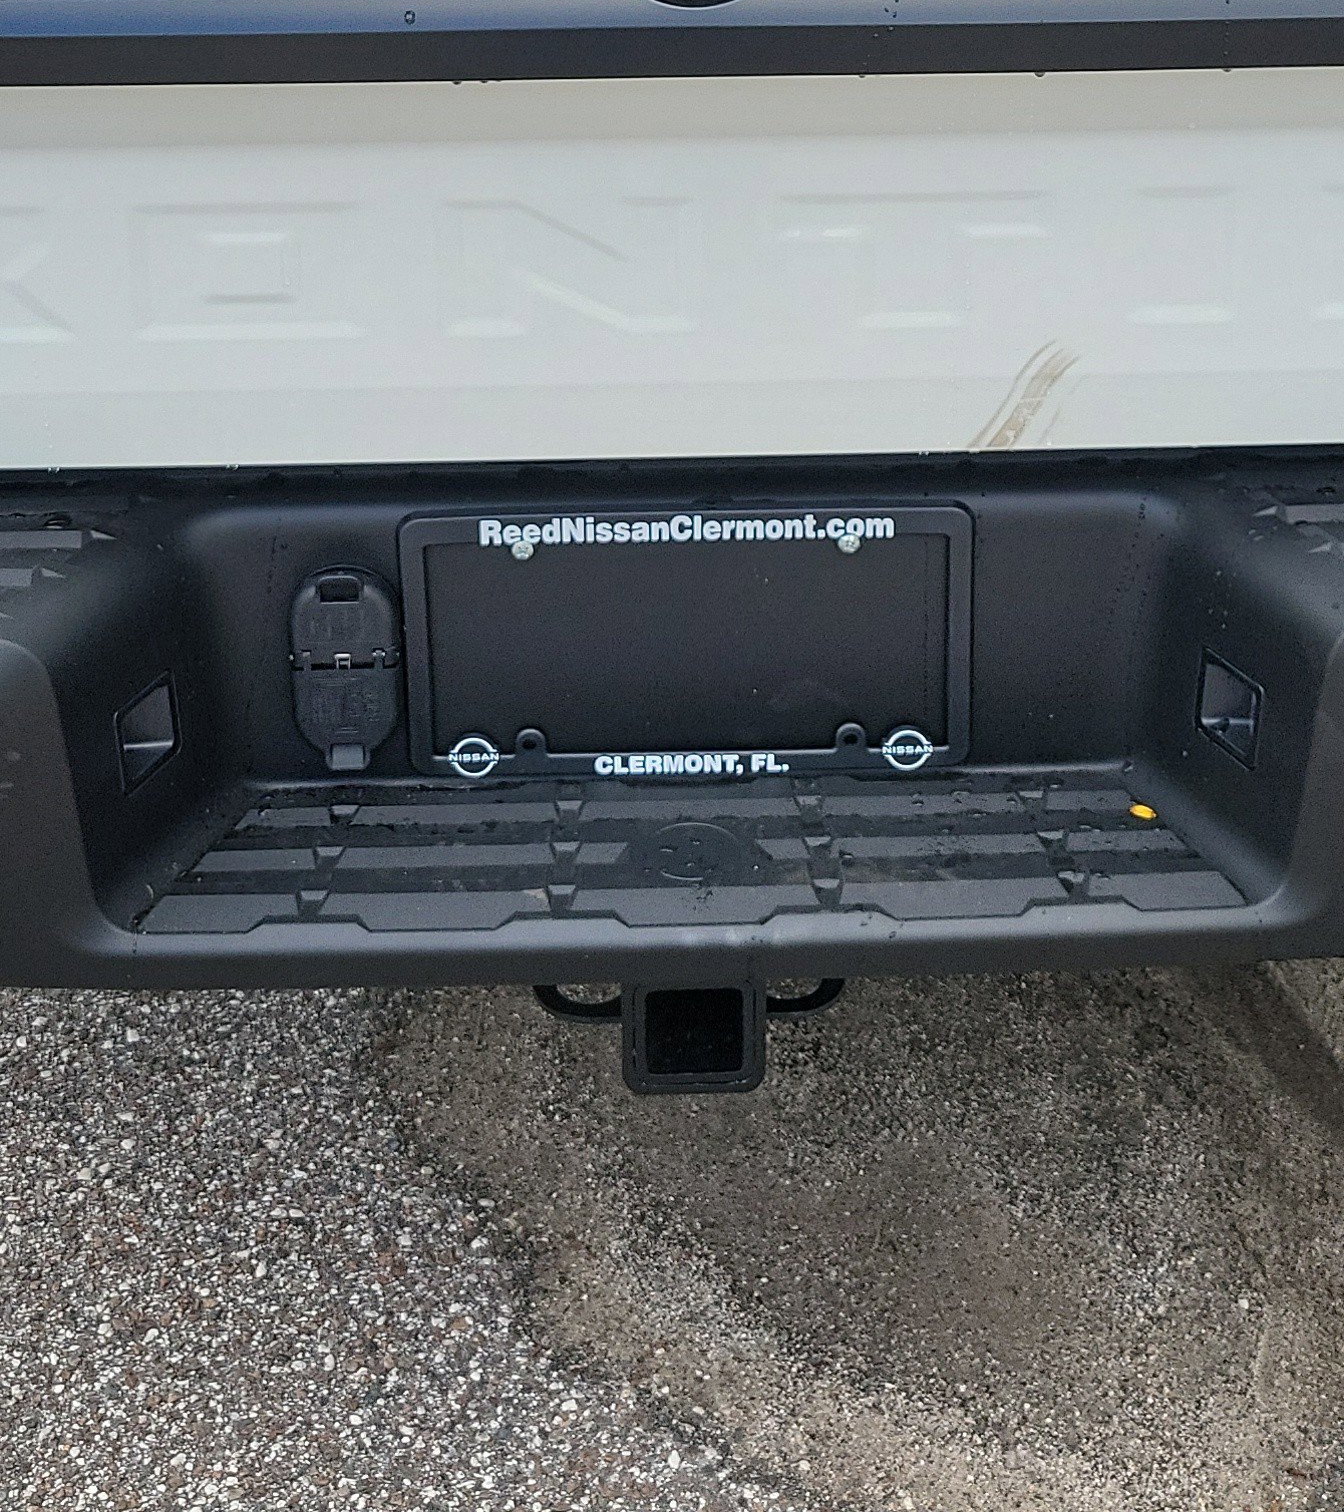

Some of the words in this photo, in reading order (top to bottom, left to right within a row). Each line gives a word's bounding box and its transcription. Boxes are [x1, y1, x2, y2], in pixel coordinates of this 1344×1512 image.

[478, 513, 895, 548] ReedNissanClermont.com
[448, 752, 499, 763] NISSAN
[882, 744, 934, 755] NISSAN
[594, 754, 745, 776] CLERMONT,
[750, 753, 790, 773] FL.
